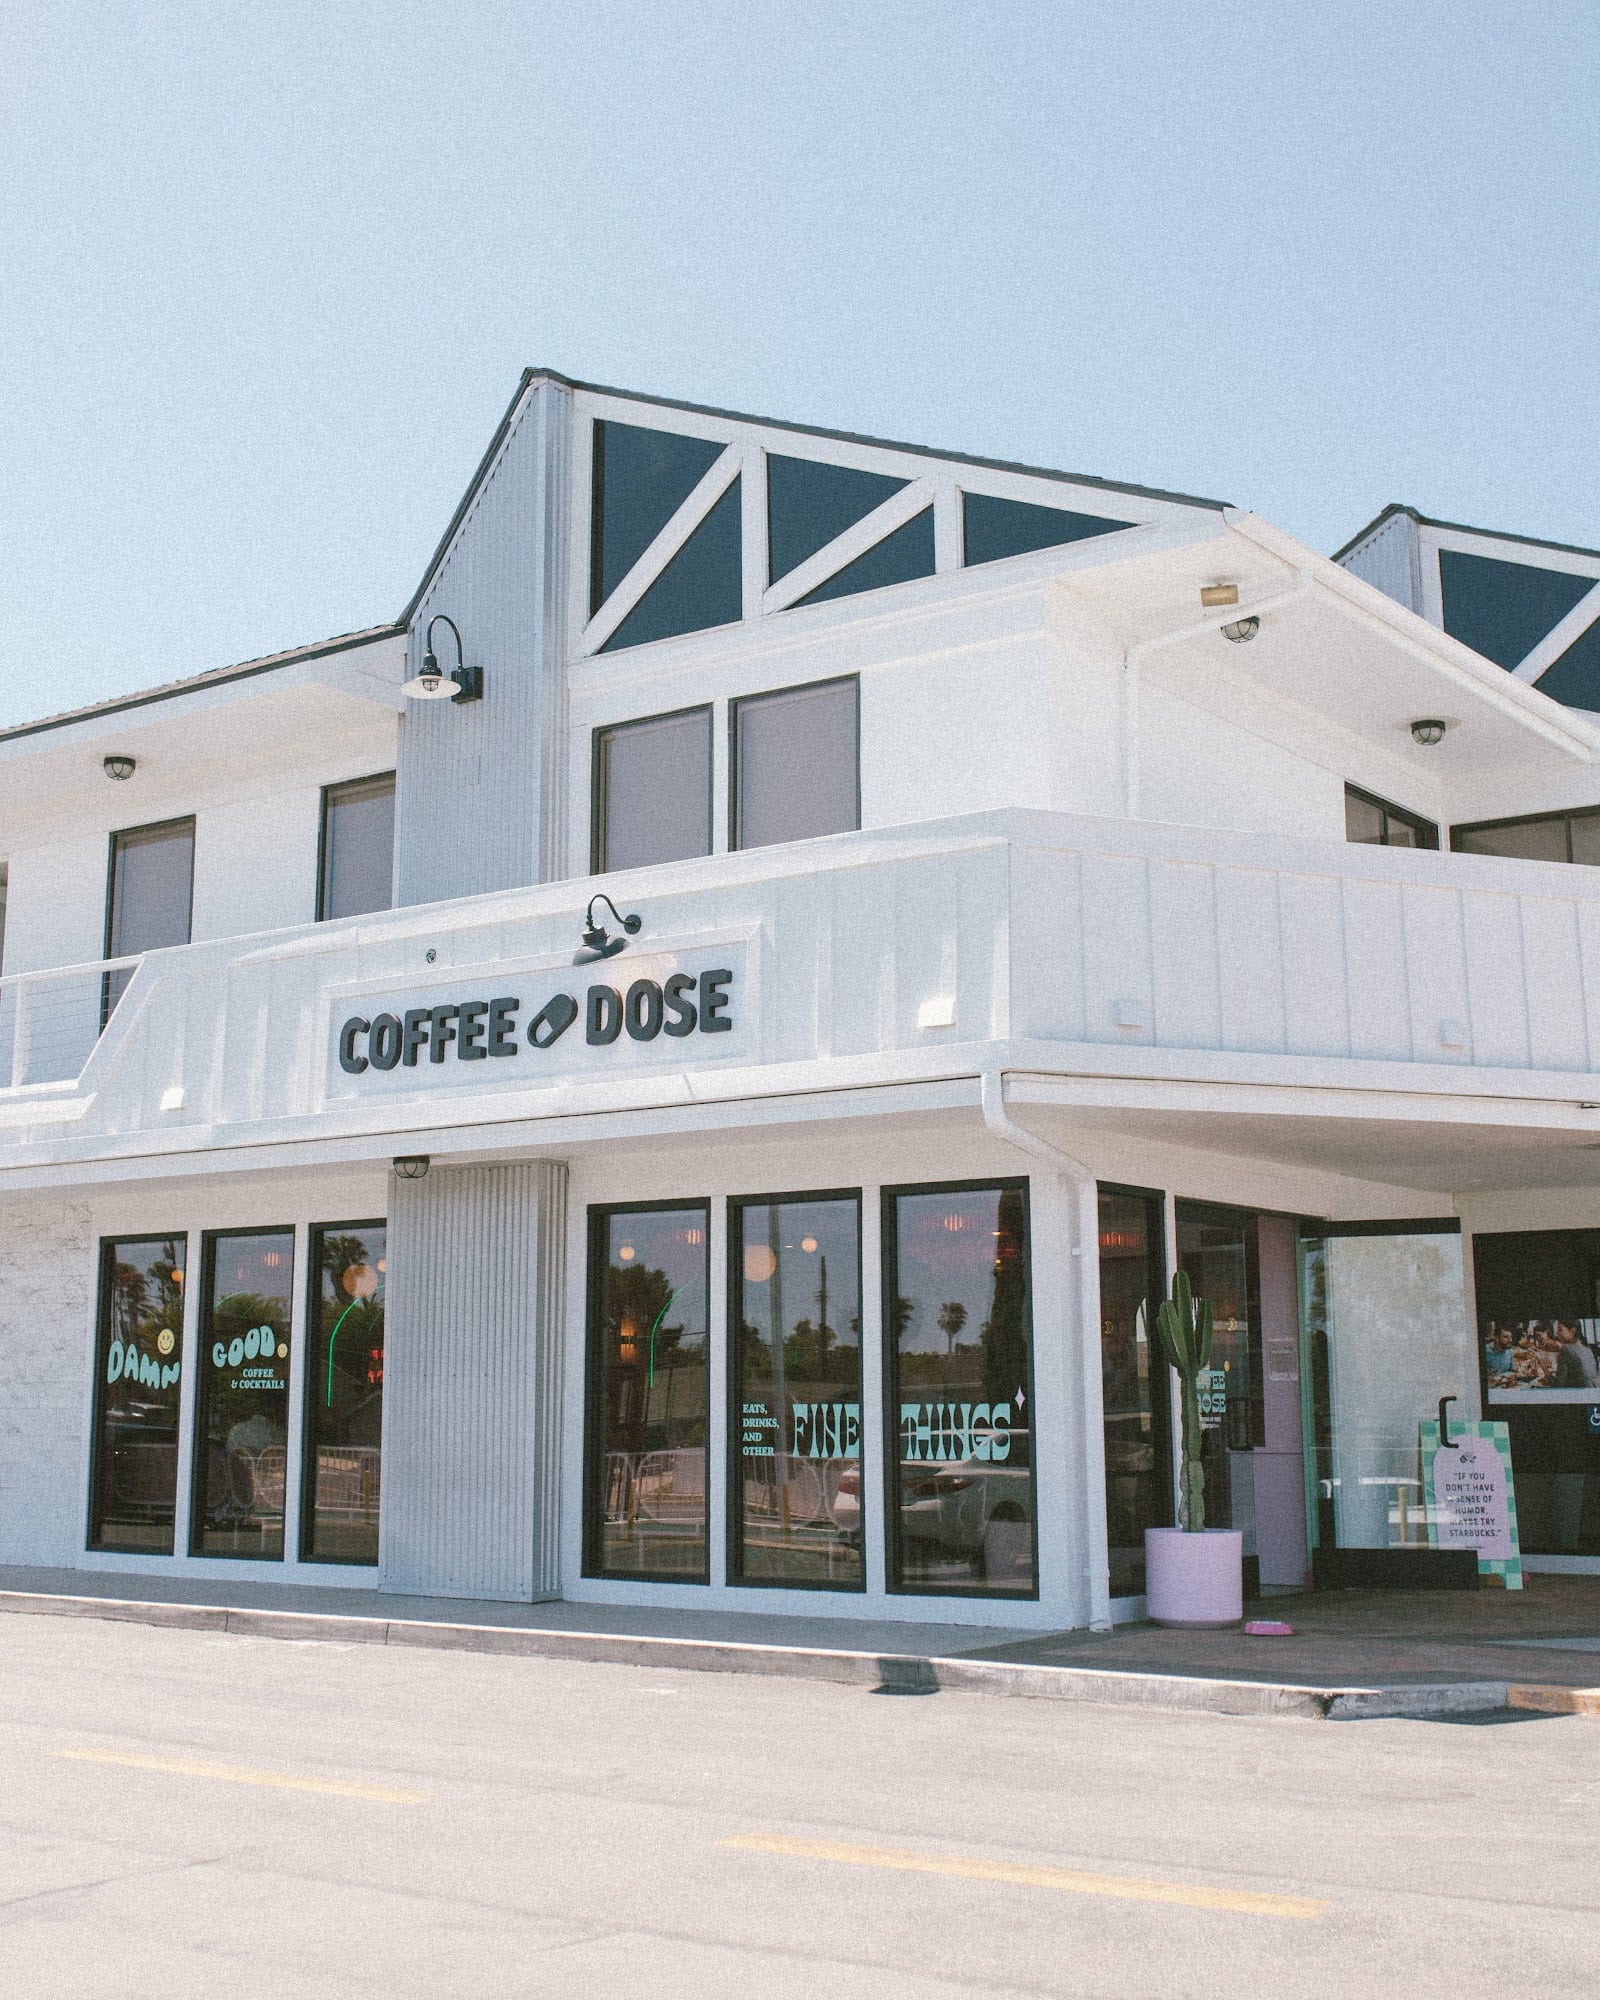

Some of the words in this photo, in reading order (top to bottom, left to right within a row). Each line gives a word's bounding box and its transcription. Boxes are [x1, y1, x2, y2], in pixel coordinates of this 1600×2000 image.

[339, 997, 519, 1074] COFFEE
[586, 968, 732, 1046] DOSE
[212, 1325, 275, 1367] GOOD
[107, 1340, 180, 1389] DAMN
[242, 1368, 274, 1377] COFFEE
[231, 1380, 238, 1389] &
[239, 1379, 285, 1389] COCKTAILS
[742, 1403, 768, 1414] EATS,
[742, 1418, 780, 1429] DRINKS,
[792, 1403, 860, 1458] FINE
[901, 1403, 1011, 1460] THINGS
[742, 1432, 762, 1442] AND
[742, 1446, 775, 1456] OTHER
[1469, 1472, 1485, 1480] YOU
[1473, 1484, 1495, 1492] HAVE
[1482, 1495, 1493, 1503] OF
[1455, 1506, 1488, 1515] HUMOR,
[1481, 1518, 1495, 1526] TRY
